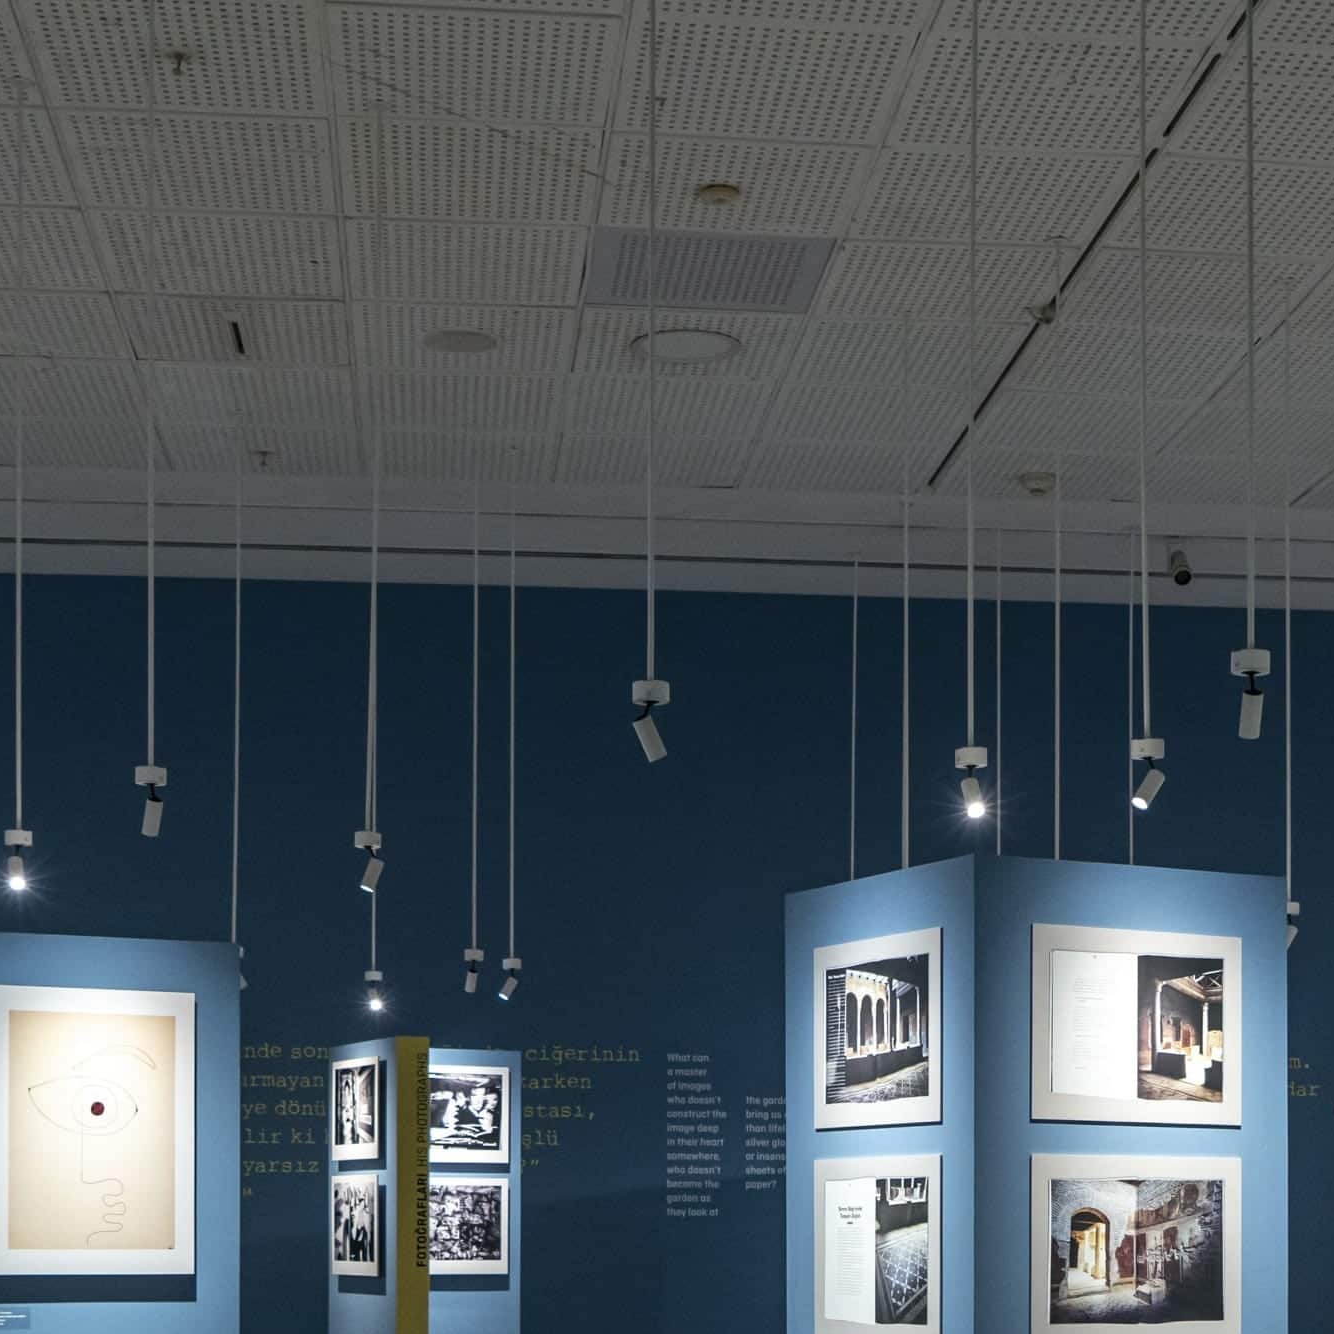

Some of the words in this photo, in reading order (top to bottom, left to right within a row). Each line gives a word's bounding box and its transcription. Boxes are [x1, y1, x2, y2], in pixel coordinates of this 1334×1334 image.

[525, 1045, 640, 1065] ciğerinin
[667, 1053, 691, 1063] What
[692, 1055, 710, 1063] can
[675, 1067, 707, 1077] master
[666, 1081, 676, 1091] of
[678, 1081, 711, 1093] images
[417, 1052, 428, 1144] PHOTOGRAPHS
[667, 1095, 686, 1105] who
[746, 1095, 761, 1105] the
[243, 1104, 267, 1120] ye
[666, 1109, 710, 1119] construct
[711, 1109, 727, 1119] the
[745, 1109, 769, 1121] bring
[666, 1123, 695, 1134] image
[697, 1123, 719, 1134] deep
[745, 1123, 766, 1133] than
[291, 1128, 315, 1144] ki
[667, 1137, 675, 1147] in
[677, 1137, 698, 1147] their
[699, 1137, 724, 1147] heart
[745, 1137, 769, 1147] silver
[417, 1146, 428, 1167] HIS
[745, 1152, 755, 1161] or
[243, 1160, 320, 1176] yarsız
[667, 1165, 686, 1175] who
[745, 1165, 776, 1175] sheets
[666, 1179, 702, 1189] become
[704, 1179, 720, 1189] the
[745, 1179, 777, 1191] paper?
[666, 1193, 699, 1204] garden
[666, 1207, 686, 1218] they
[687, 1207, 708, 1217] look
[709, 1207, 719, 1217] at
[415, 1173, 428, 1268] FOTOĞRAFLARI
